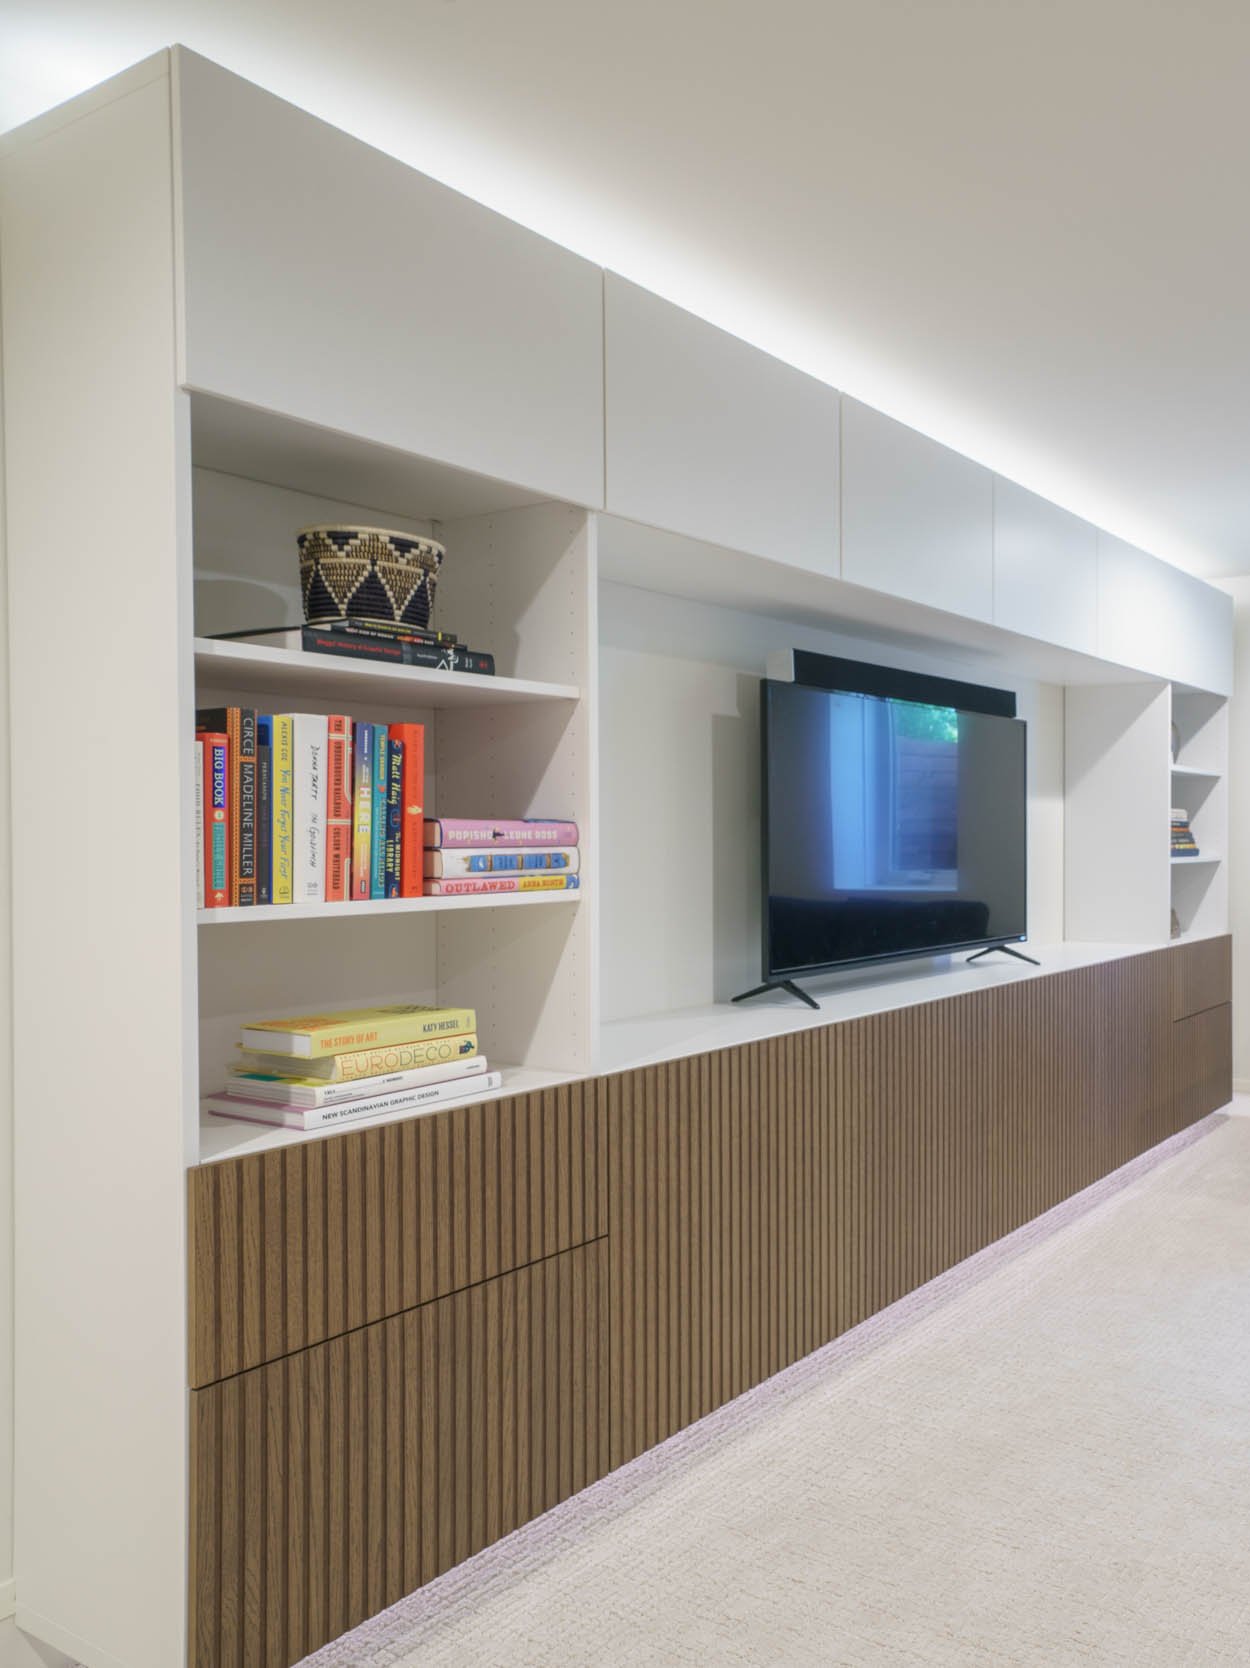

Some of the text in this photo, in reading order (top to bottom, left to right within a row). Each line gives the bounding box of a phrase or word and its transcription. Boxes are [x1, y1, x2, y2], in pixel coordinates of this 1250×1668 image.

[243, 718, 254, 755] CIRCE
[214, 748, 224, 770] BIG
[214, 772, 224, 807] BOOK
[387, 753, 402, 805] Matt Haig
[242, 764, 254, 829] MADELINE
[242, 833, 253, 876] MILLER
[279, 834, 290, 855] Your
[386, 840, 395, 873] LIBRARY
[280, 857, 289, 880] First
[445, 880, 517, 894] OUTLAWED
[320, 1031, 378, 1049] THE STORY OF ART
[422, 1019, 460, 1033] KATY HESSEL
[340, 1043, 452, 1077] EURODECO
[322, 1090, 439, 1121] NEW SCANDINAVIAN GRAPHIC DESIGN
